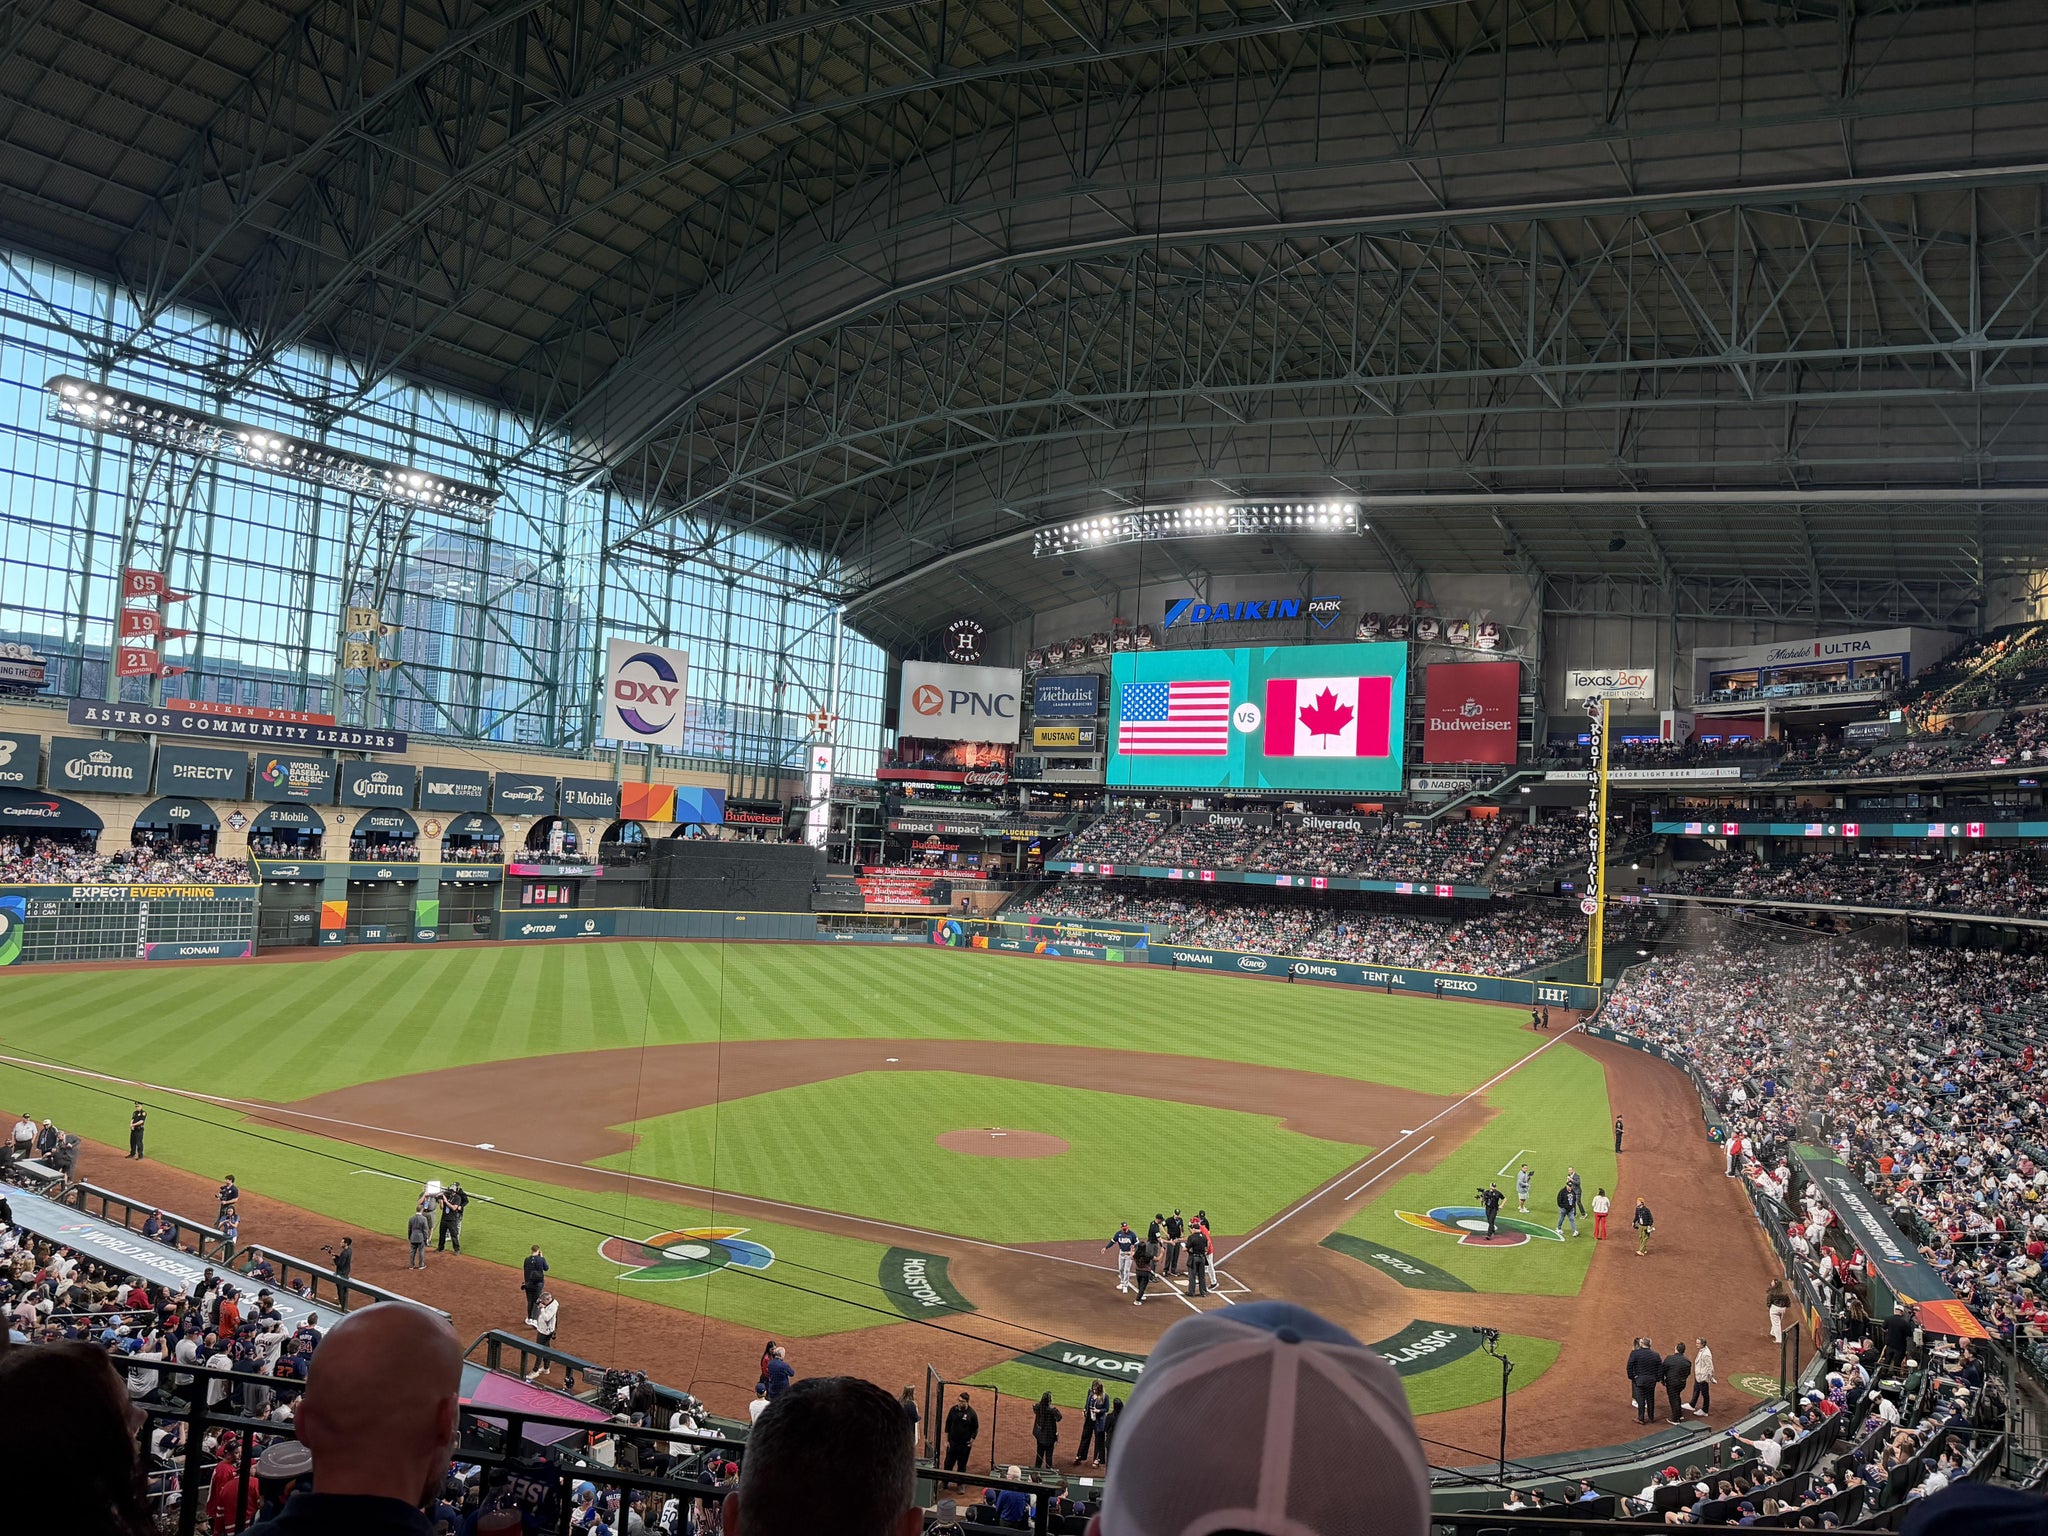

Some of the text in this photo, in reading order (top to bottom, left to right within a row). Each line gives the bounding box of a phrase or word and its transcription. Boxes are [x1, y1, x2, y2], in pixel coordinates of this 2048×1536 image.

[133, 575, 156, 591] 05
[1190, 598, 1342, 623] DAIKIN PARK
[132, 616, 153, 631] 19
[355, 613, 372, 626] 17
[949, 620, 984, 634] HOUSTON
[957, 633, 974, 649] H
[352, 650, 368, 661] 22
[949, 650, 980, 661] ASTROS
[1767, 640, 1872, 661] Michelob ULTRA
[127, 653, 148, 667] 21
[15, 668, 29, 677] THE
[29, 669, 41, 678] GO
[1573, 671, 1649, 690] Texas Bay
[615, 680, 680, 707] OXY
[1039, 688, 1093, 701] Methodist
[948, 690, 1015, 718] PNC
[189, 702, 309, 721] DAIKIN PARK
[1238, 712, 1255, 723] VS
[85, 708, 395, 747] ASTROS COMMUNITY LEADERS
[1041, 731, 1093, 742] MUSTANG CAT
[1590, 723, 1601, 767] ROOT
[65, 758, 134, 782] Corona
[173, 764, 233, 781] DIRECTV
[290, 762, 320, 771] WORLD
[289, 769, 330, 778] BASEBALL
[1588, 771, 1599, 784] 4
[353, 778, 404, 798] Corona
[455, 784, 482, 792] NIPPON
[455, 789, 482, 797] EXPRESS
[577, 790, 613, 806] Mobile
[169, 806, 191, 819] dip
[280, 812, 309, 822] Mobile
[725, 811, 783, 824] Budweiser
[370, 817, 405, 827] DIRECTV
[1208, 813, 1245, 826] Chevy
[1302, 816, 1361, 831] Silverado
[898, 822, 934, 833] impact
[944, 825, 980, 836] impact
[1001, 829, 1039, 837] PLUCKERS
[1586, 828, 1598, 896] CHIKIN
[377, 868, 392, 879] dip
[884, 868, 921, 876] Budweiser
[943, 870, 976, 878] Budweiser
[72, 887, 214, 898] EXPECT EVERYTHING
[884, 895, 922, 904] Budweiser
[294, 914, 310, 922] 366
[366, 930, 381, 938] IHI
[532, 925, 544, 933] ITO
[180, 946, 220, 955] KONAMI
[1173, 952, 1213, 964] KONAMI
[1310, 966, 1337, 976] MUFG
[1362, 970, 1406, 984] TENTAL
[1434, 978, 1478, 992] SEIKO
[79, 1230, 143, 1255] WORLD
[1117, 1237, 1132, 1245] USA
[1370, 1253, 1427, 1275] 2026
[902, 1258, 947, 1307] HOUSTON
[1062, 1351, 1145, 1374] WOR
[277, 1365, 294, 1377] 27
[662, 1509, 677, 1524] 50
